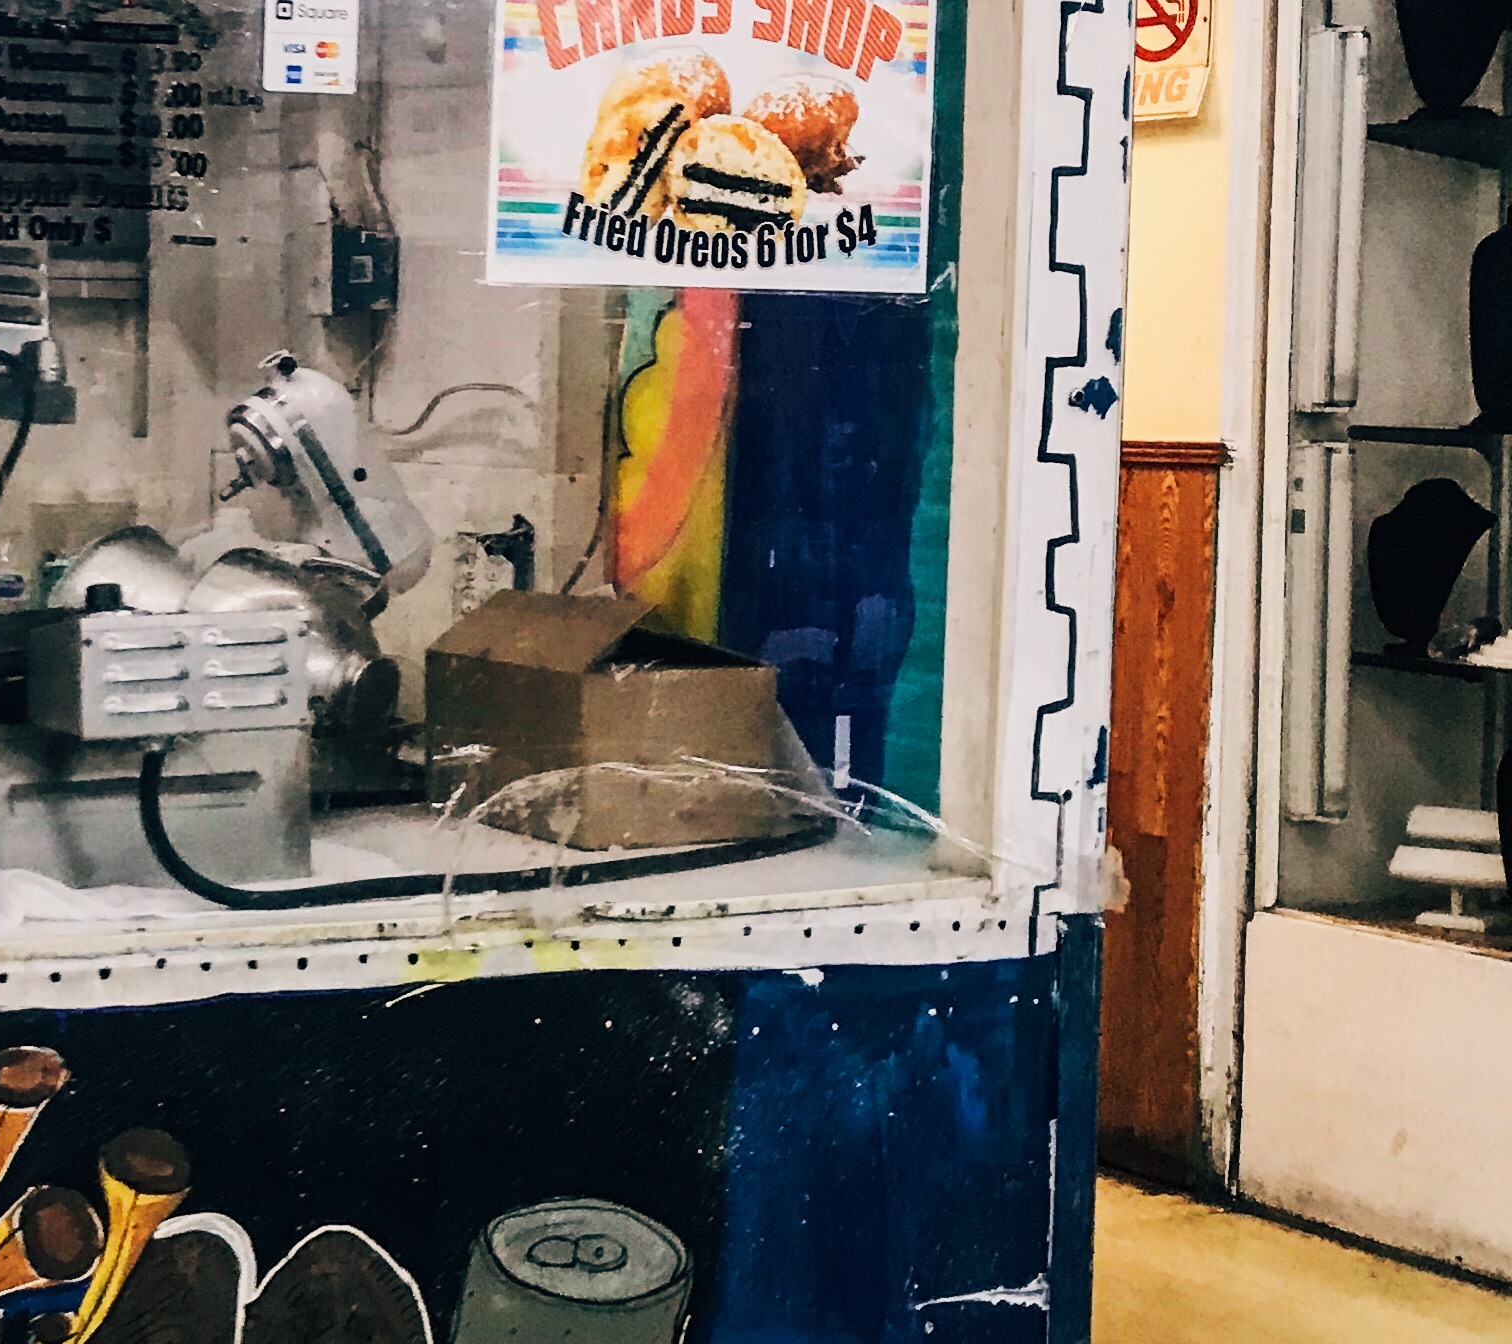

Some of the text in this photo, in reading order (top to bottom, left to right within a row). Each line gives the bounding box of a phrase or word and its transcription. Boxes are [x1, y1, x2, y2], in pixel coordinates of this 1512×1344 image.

[297, 3, 349, 23] Square
[562, 191, 878, 270] Fried Oreos 6 for $4
